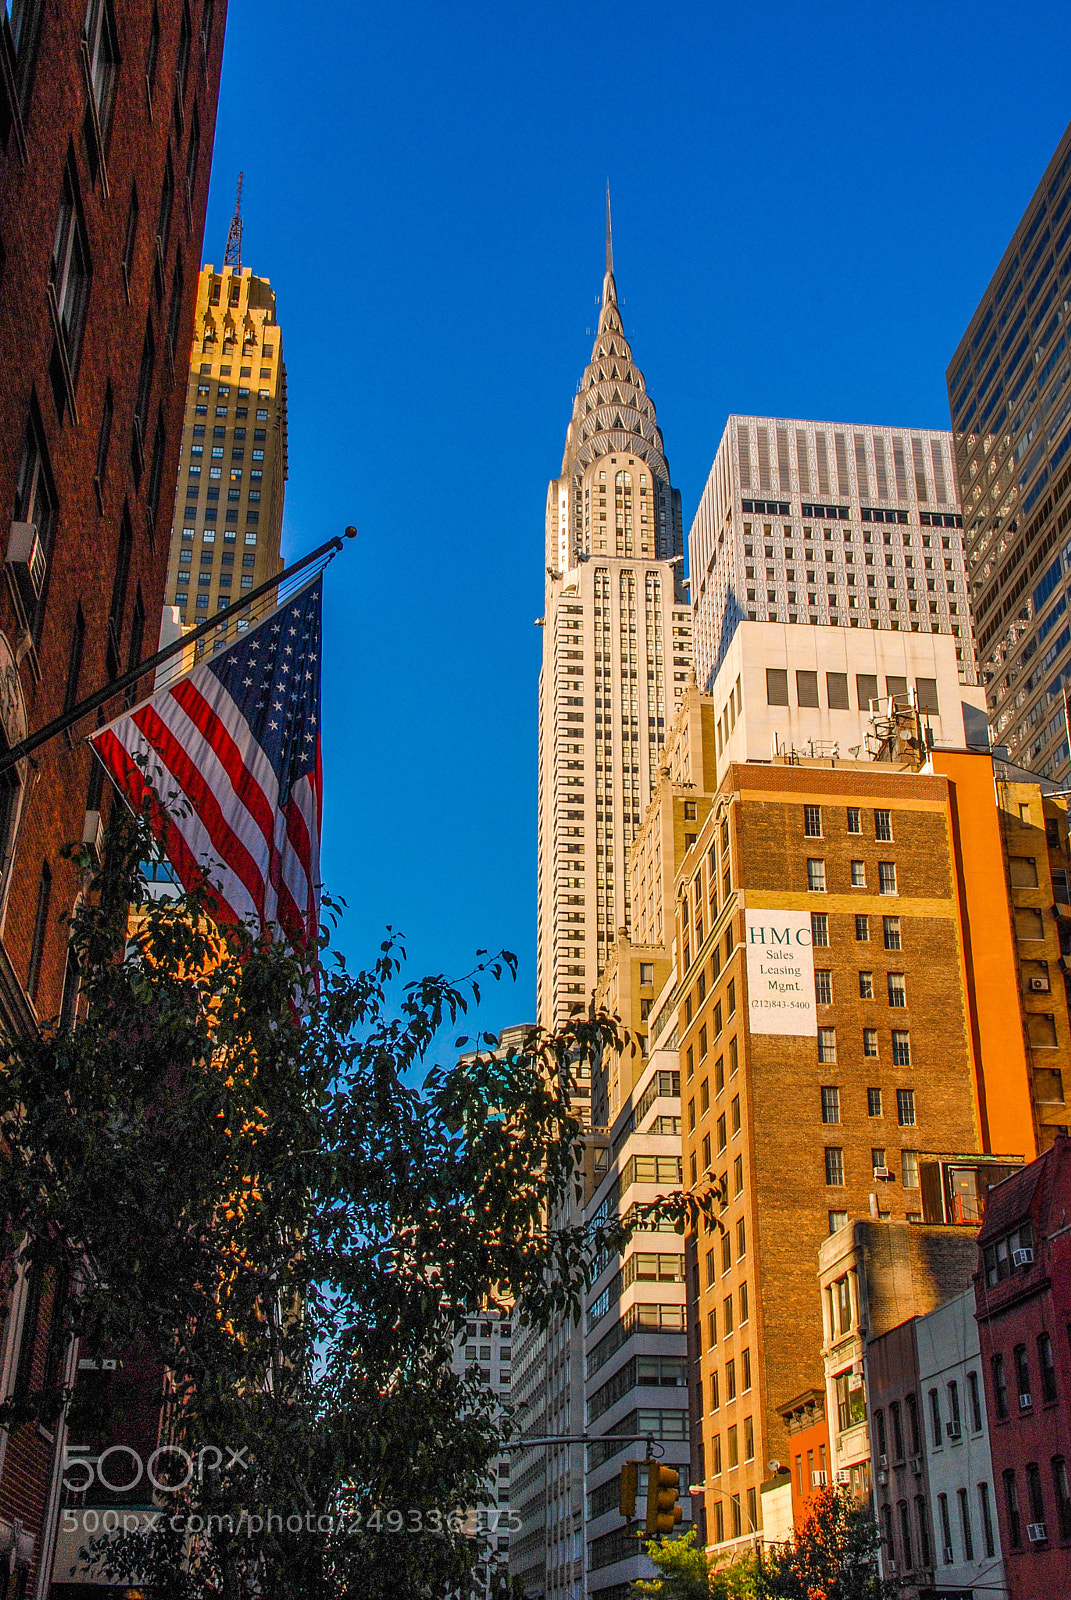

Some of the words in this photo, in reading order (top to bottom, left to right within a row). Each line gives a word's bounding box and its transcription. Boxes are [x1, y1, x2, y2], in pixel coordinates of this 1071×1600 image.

[749, 927, 812, 946] HMC
[766, 950, 794, 960] Sales
[760, 964, 802, 977] Leasing
[768, 980, 804, 993] Mgmt.
[751, 999, 811, 1010] (212)843-5400
